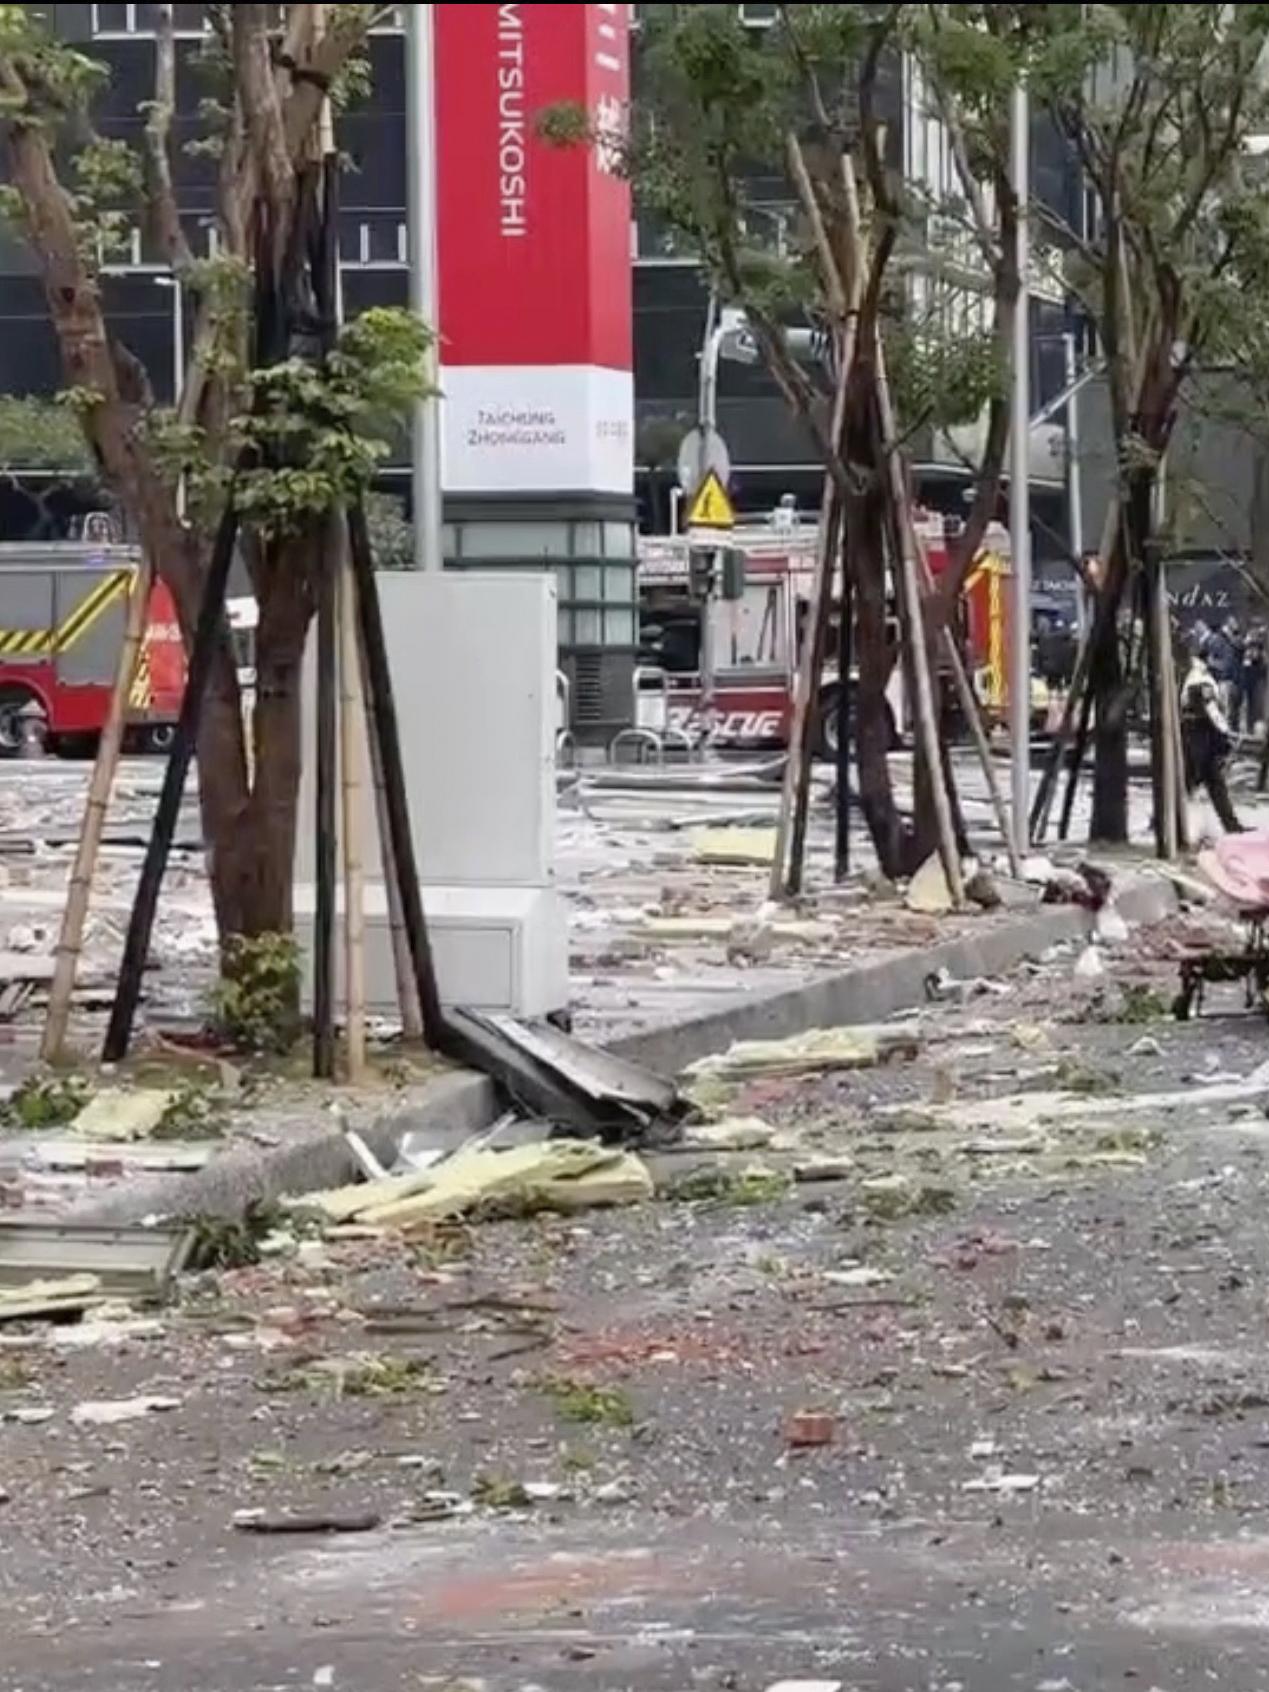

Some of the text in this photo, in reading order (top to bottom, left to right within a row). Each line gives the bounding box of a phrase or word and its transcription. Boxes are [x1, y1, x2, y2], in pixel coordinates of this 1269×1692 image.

[498, 3, 526, 237] MITSUKOSHI
[477, 409, 556, 426] TAICHUNG
[467, 428, 567, 446] ZHONGGANG
